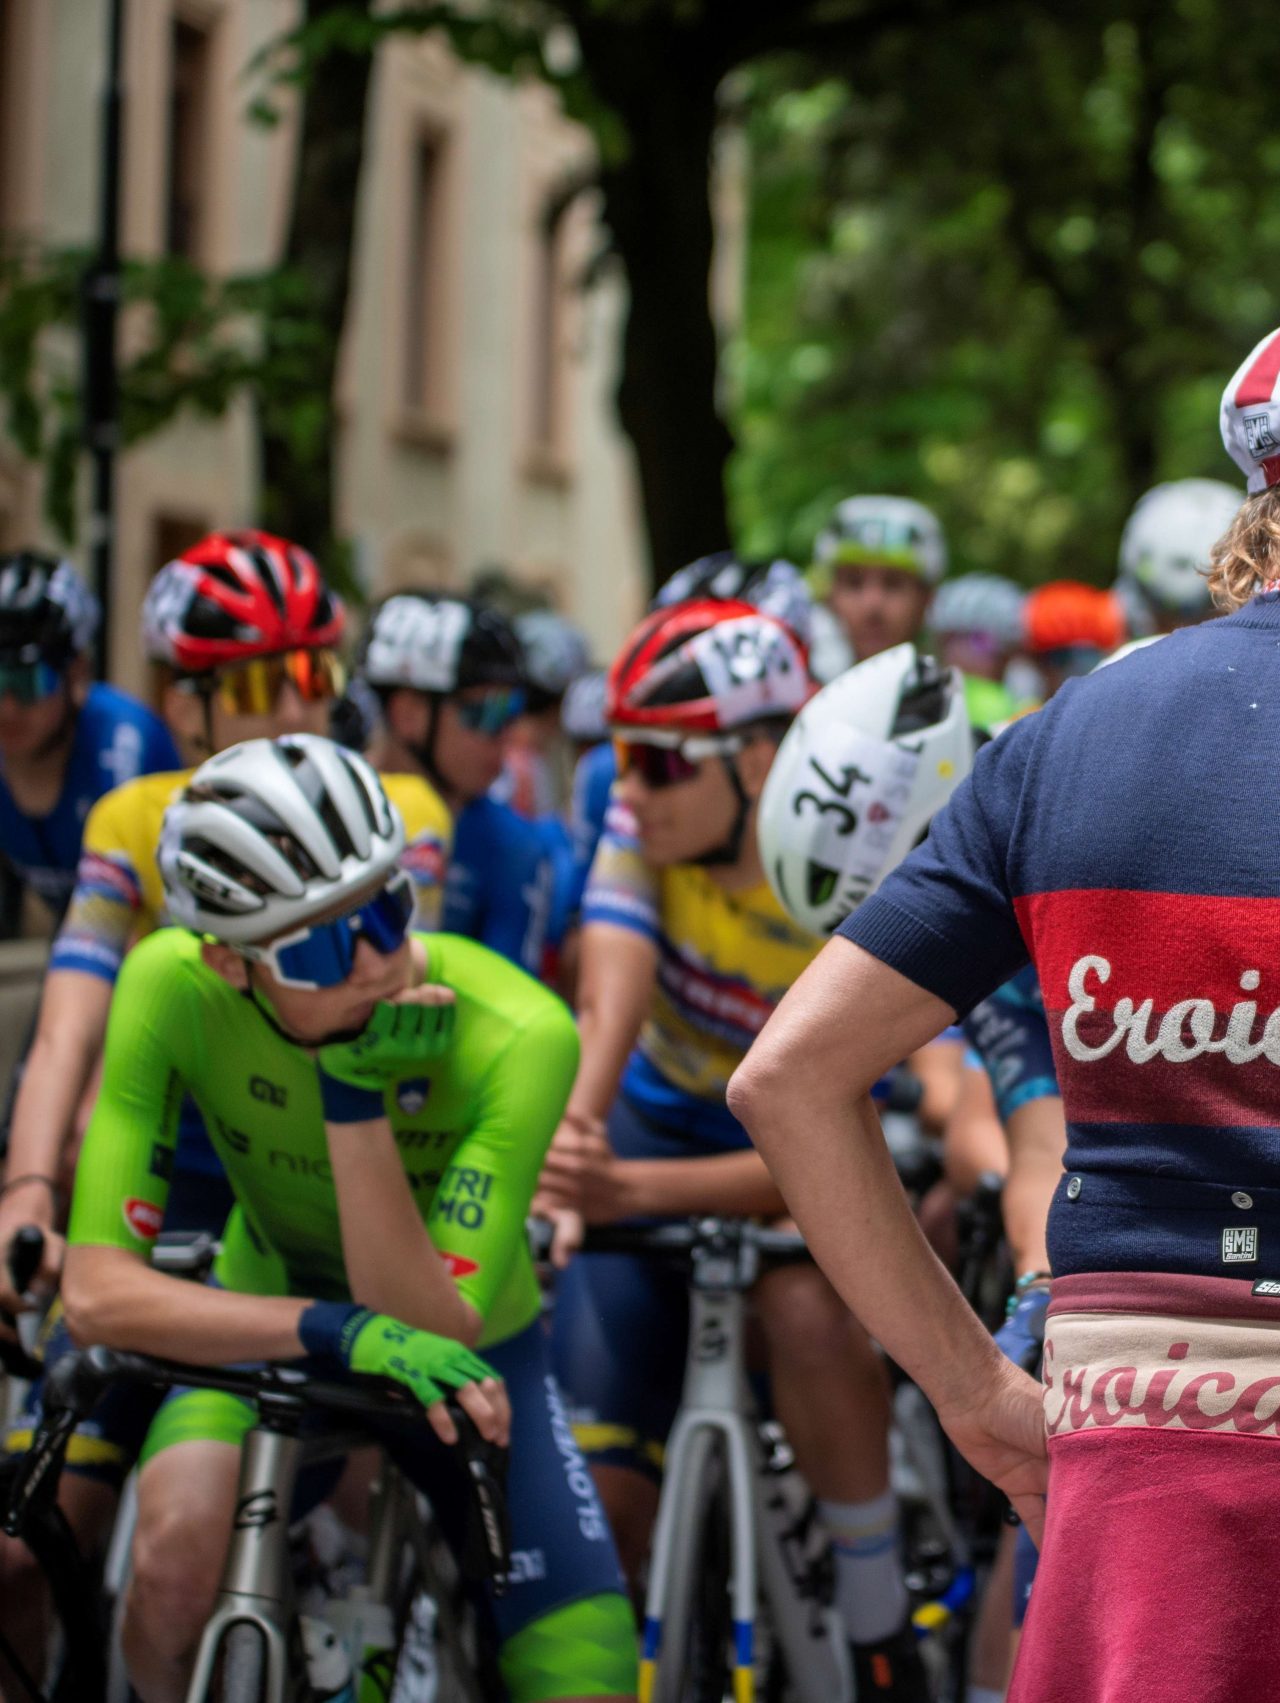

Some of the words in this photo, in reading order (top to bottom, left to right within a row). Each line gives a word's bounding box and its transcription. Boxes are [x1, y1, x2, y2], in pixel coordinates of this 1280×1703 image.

[794, 755, 873, 836] 34
[1225, 1230, 1255, 1253] SMS
[1225, 1251, 1253, 1260] Santini
